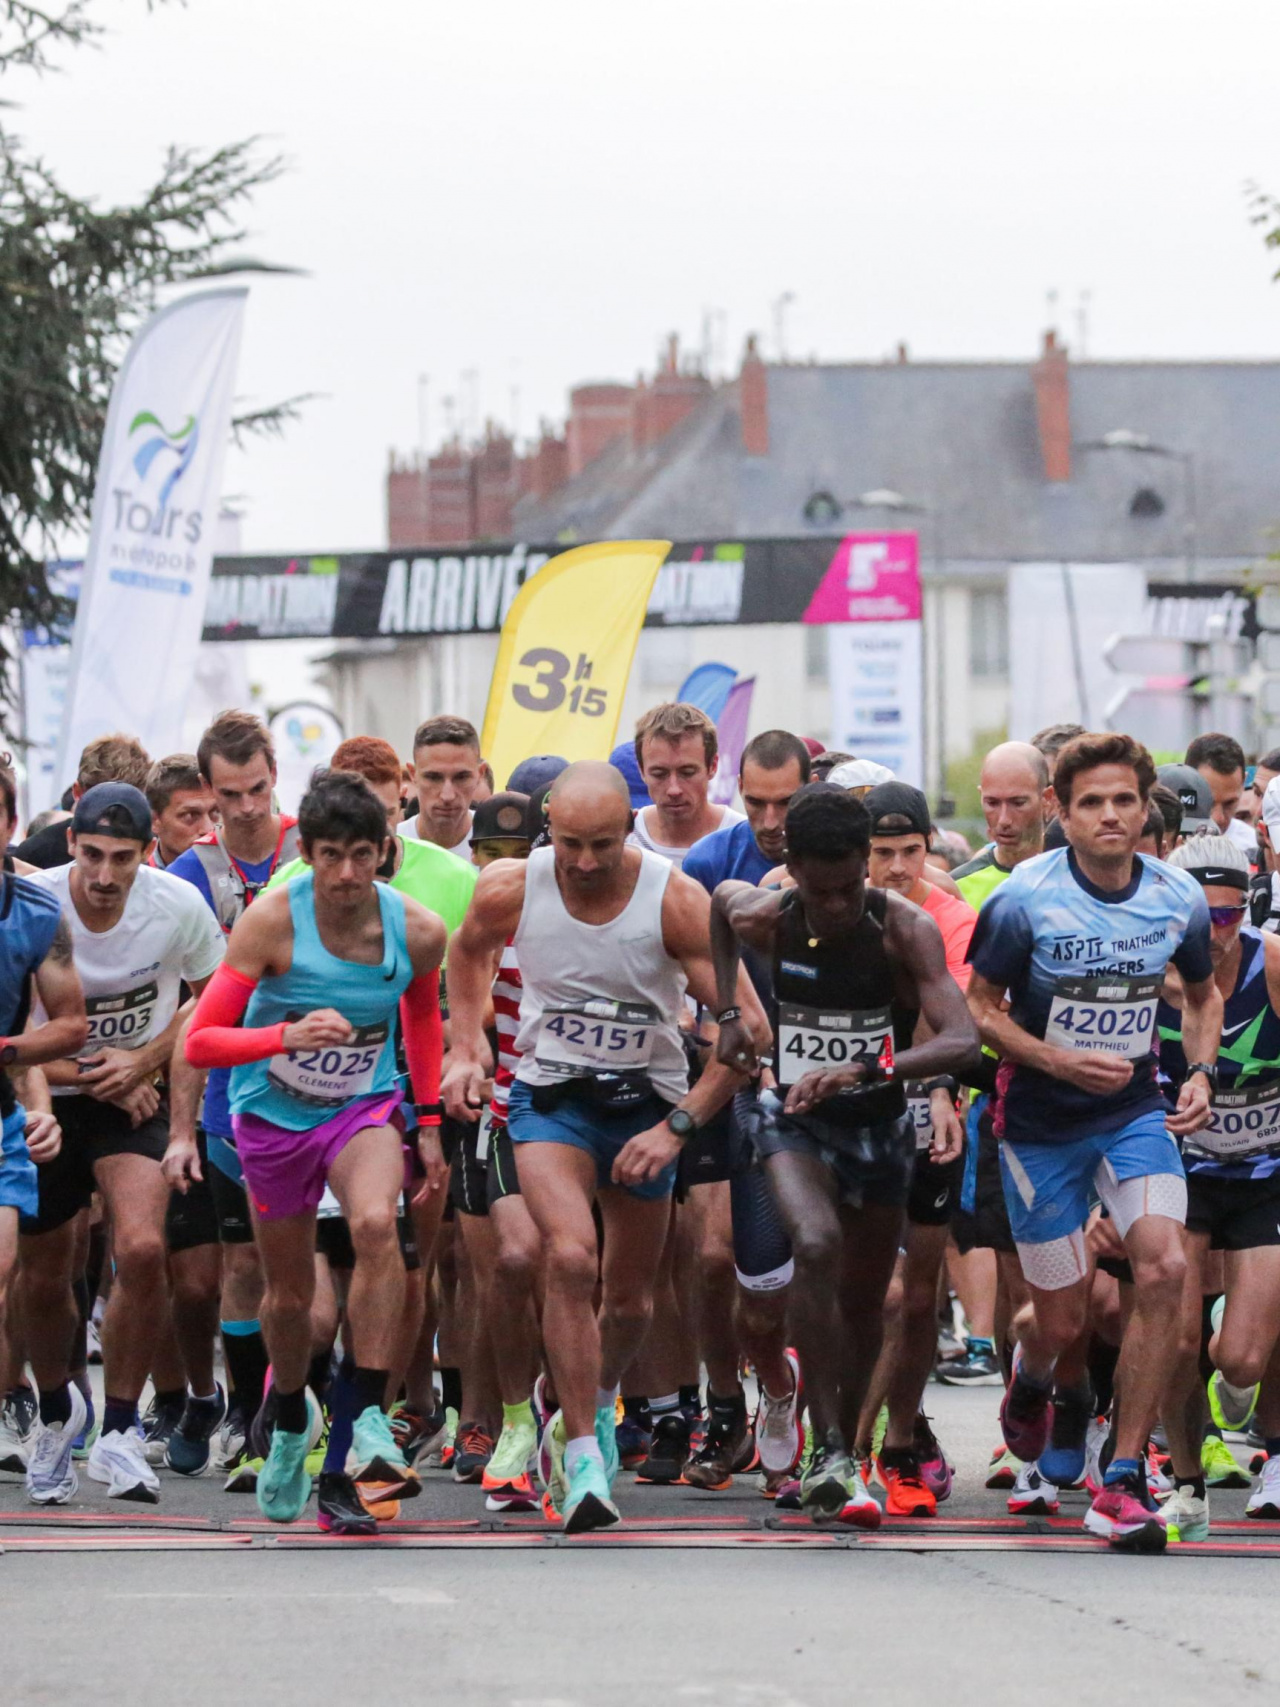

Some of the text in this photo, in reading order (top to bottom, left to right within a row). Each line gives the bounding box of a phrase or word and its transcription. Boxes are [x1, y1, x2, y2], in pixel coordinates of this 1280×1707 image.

[379, 542, 545, 633] ARRIVÉ
[1053, 929, 1166, 964] ASPTT TRIATHLON
[1084, 958, 1145, 979] ANGERS
[87, 1007, 151, 1038] 2003
[545, 1016, 647, 1050] 42151
[1053, 1006, 1152, 1036] 42020
[785, 1033, 889, 1062] 42027
[1074, 1039, 1130, 1050] MATTHIEU
[298, 1074, 348, 1090] CLEMENT
[1220, 1139, 1250, 1148] SYLVAIN
